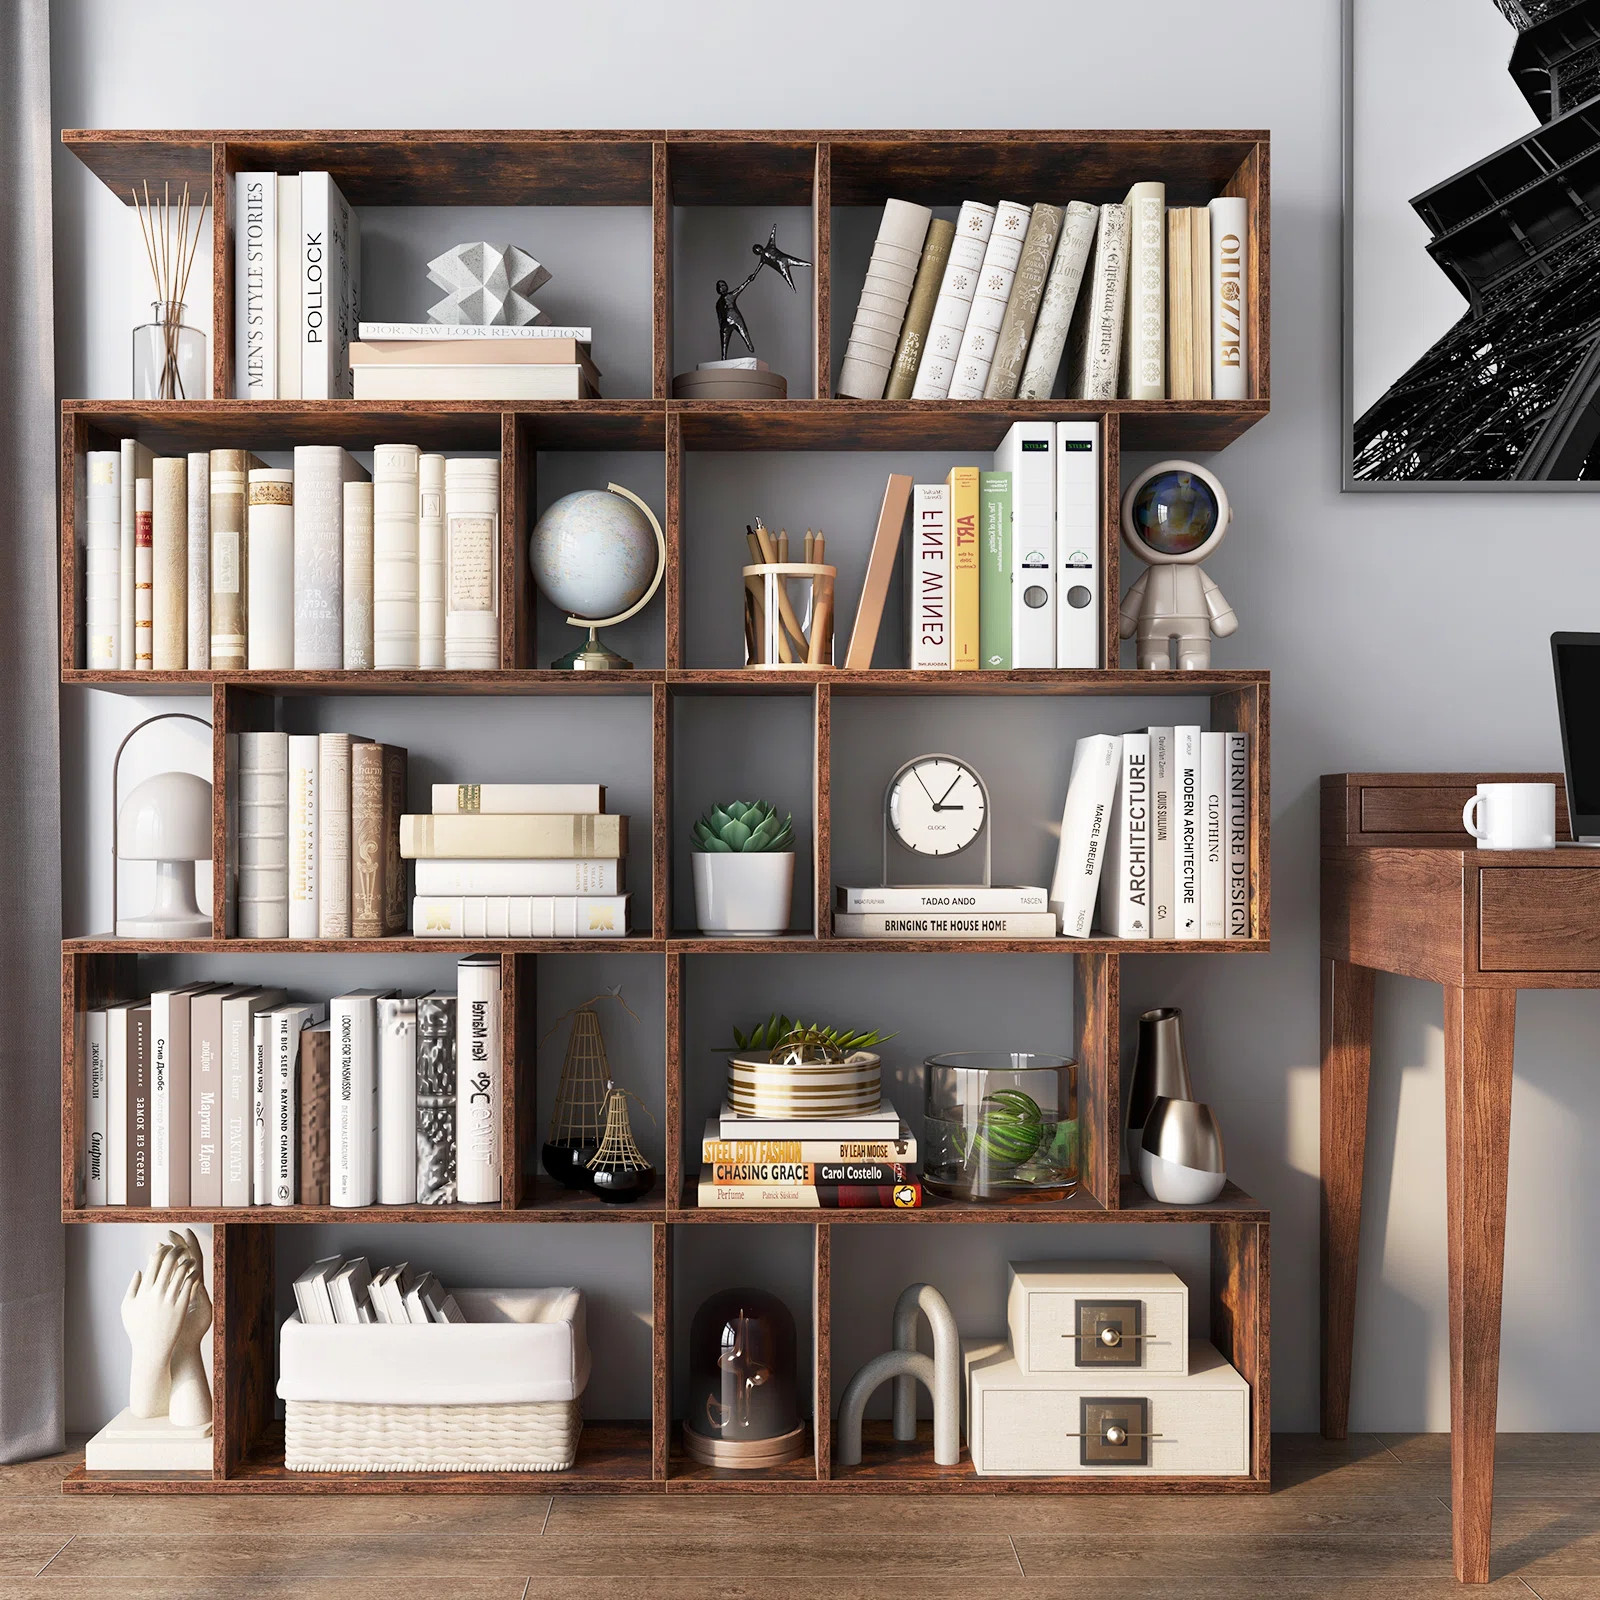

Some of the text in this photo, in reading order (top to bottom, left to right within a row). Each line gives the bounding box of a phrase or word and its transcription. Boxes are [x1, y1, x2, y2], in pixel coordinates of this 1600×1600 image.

[247, 182, 264, 388] MEN'S STYLE STORIES
[307, 232, 322, 343] POLLOCK
[409, 326, 441, 336] NEW
[447, 327, 486, 336] LOOK
[492, 327, 585, 339] REVOLUTION
[1085, 803, 1105, 876] MARCEL BREUER
[1129, 754, 1146, 906] ARCHITECTURE
[1157, 791, 1167, 841] LOUIS SULLIVAN
[1183, 768, 1194, 904] MODERN ARCHITECTURE
[1208, 794, 1219, 863] CLOTHING
[1231, 736, 1245, 936] FURNITURE DESIGN
[294, 829, 306, 901] Furniture
[885, 920, 1007, 931] BRINGING THE HOUSE HOME
[921, 897, 976, 906] TADAO ANDO
[1157, 904, 1167, 920] CCA
[157, 1038, 165, 1060] Стив
[342, 1014, 351, 1101] LOOKING FOR TRANSMISSION
[156, 1061, 165, 1091] Джобс
[232, 1075, 242, 1100] Кант
[280, 1019, 288, 1179] THE BIG SLEEP RAYMOND CHANDLER
[88, 1131, 103, 1180] Спартак
[136, 1097, 145, 1187] замок из стекла
[198, 1092, 215, 1175] Мартин Иден
[230, 1116, 242, 1182] ТРАКТАТЫ
[704, 1141, 802, 1163] STEEL CITY FASHION
[840, 1145, 888, 1158] BY LEAH MOOSE
[717, 1165, 809, 1180] CHASING GRACE
[717, 1188, 745, 1200] Perfume
[762, 1190, 779, 1200] Patrick
[821, 1166, 882, 1180] Carol Costello
